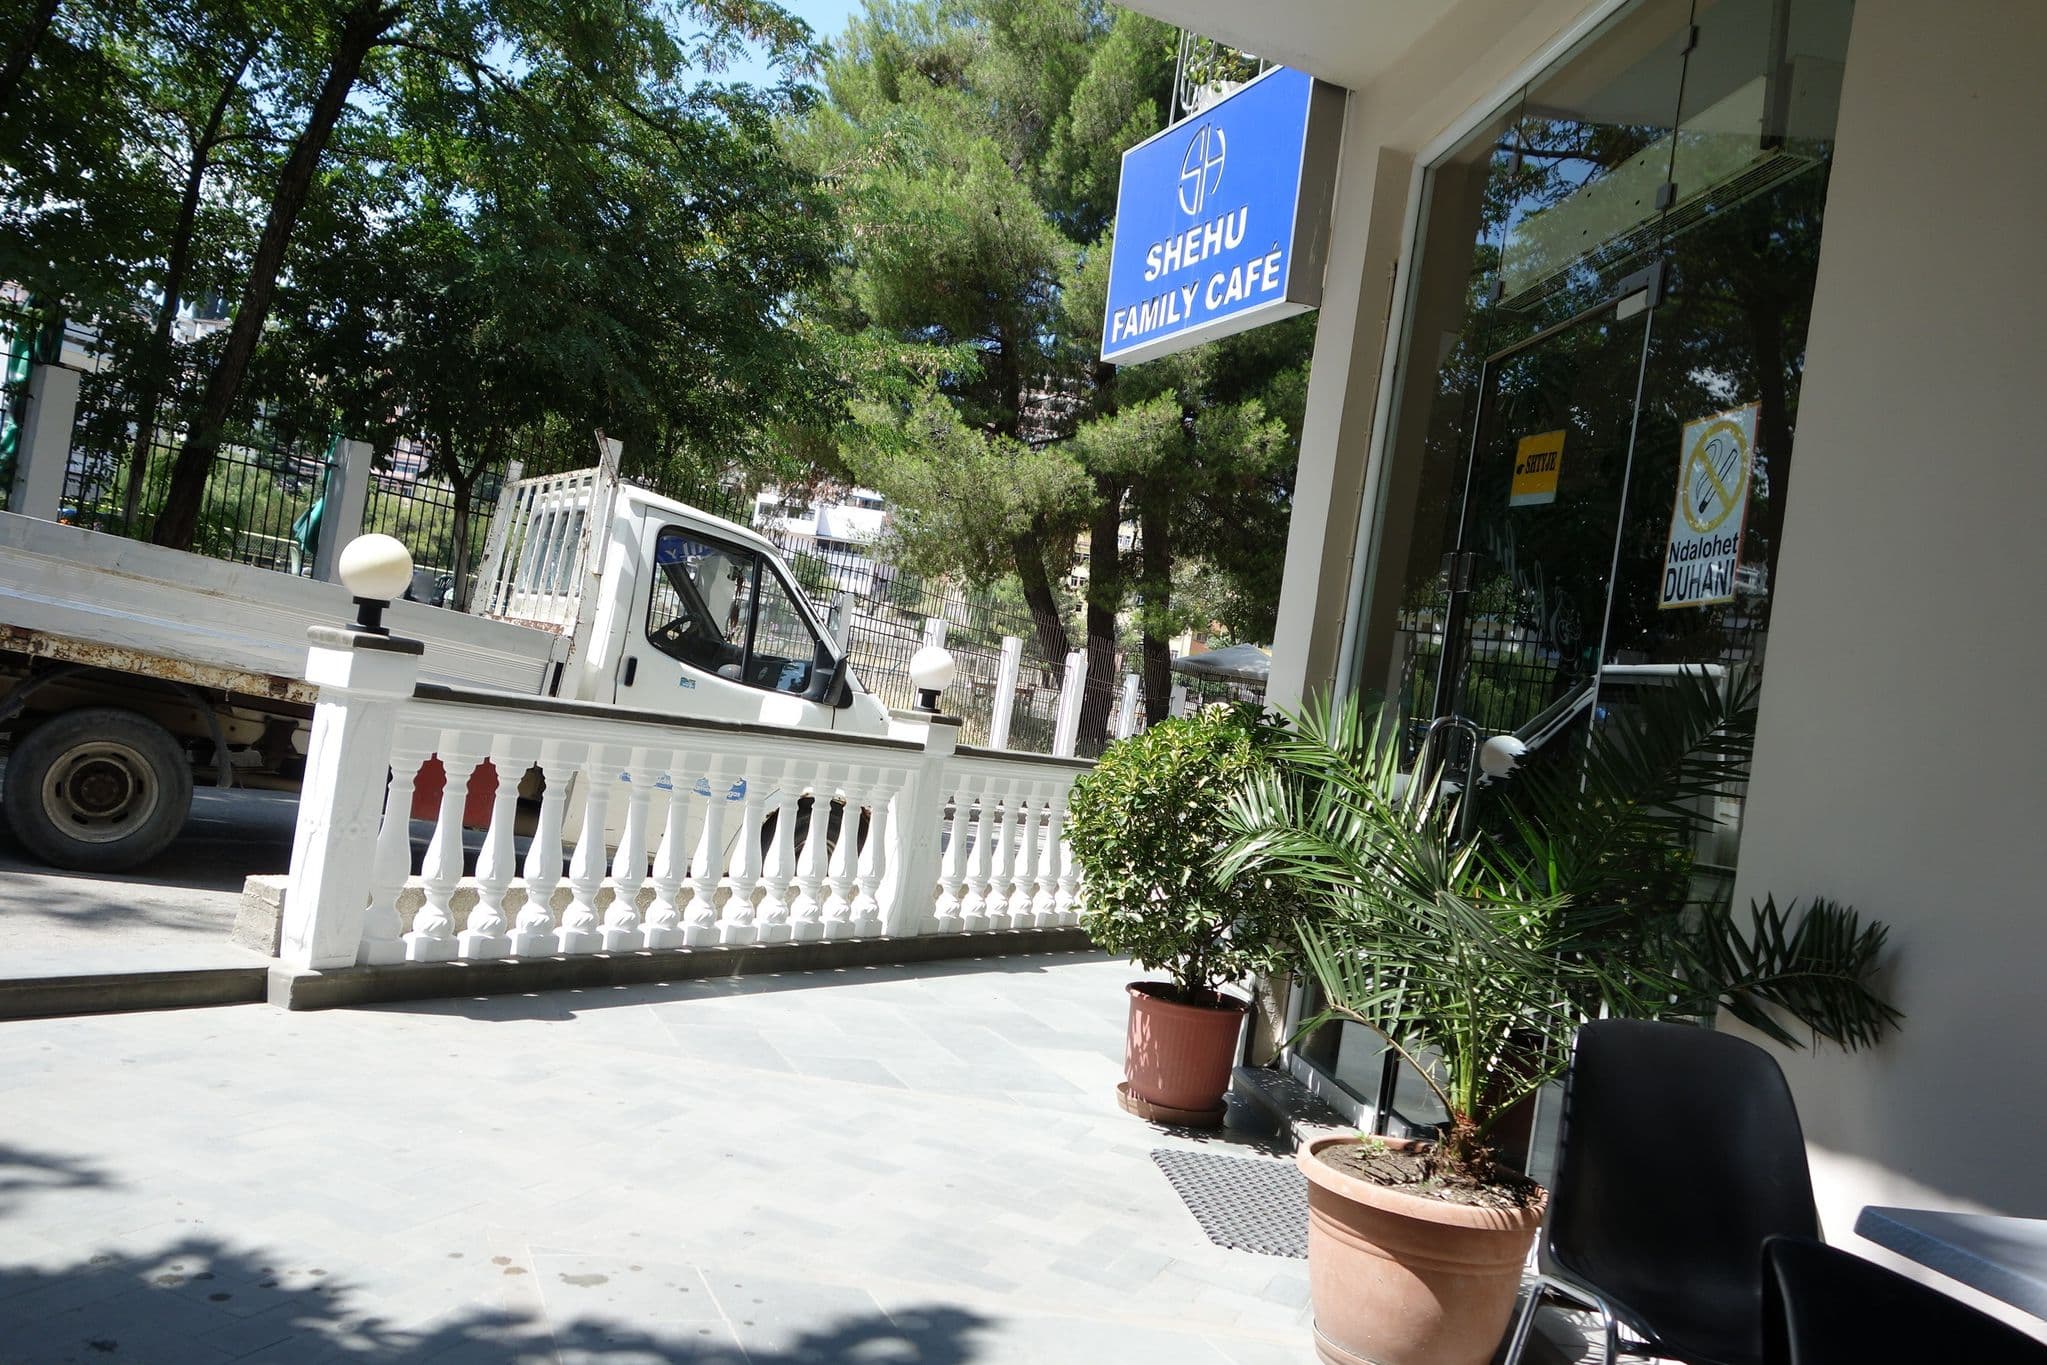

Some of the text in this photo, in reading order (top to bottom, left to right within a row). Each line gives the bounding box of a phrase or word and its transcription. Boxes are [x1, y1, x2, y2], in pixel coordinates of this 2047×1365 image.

[1144, 205, 1248, 282] SHEHU
[1111, 241, 1282, 344] FAMILY CAFÉ
[1668, 532, 1739, 563] Ndalohet
[1664, 559, 1735, 602] DUHANI
